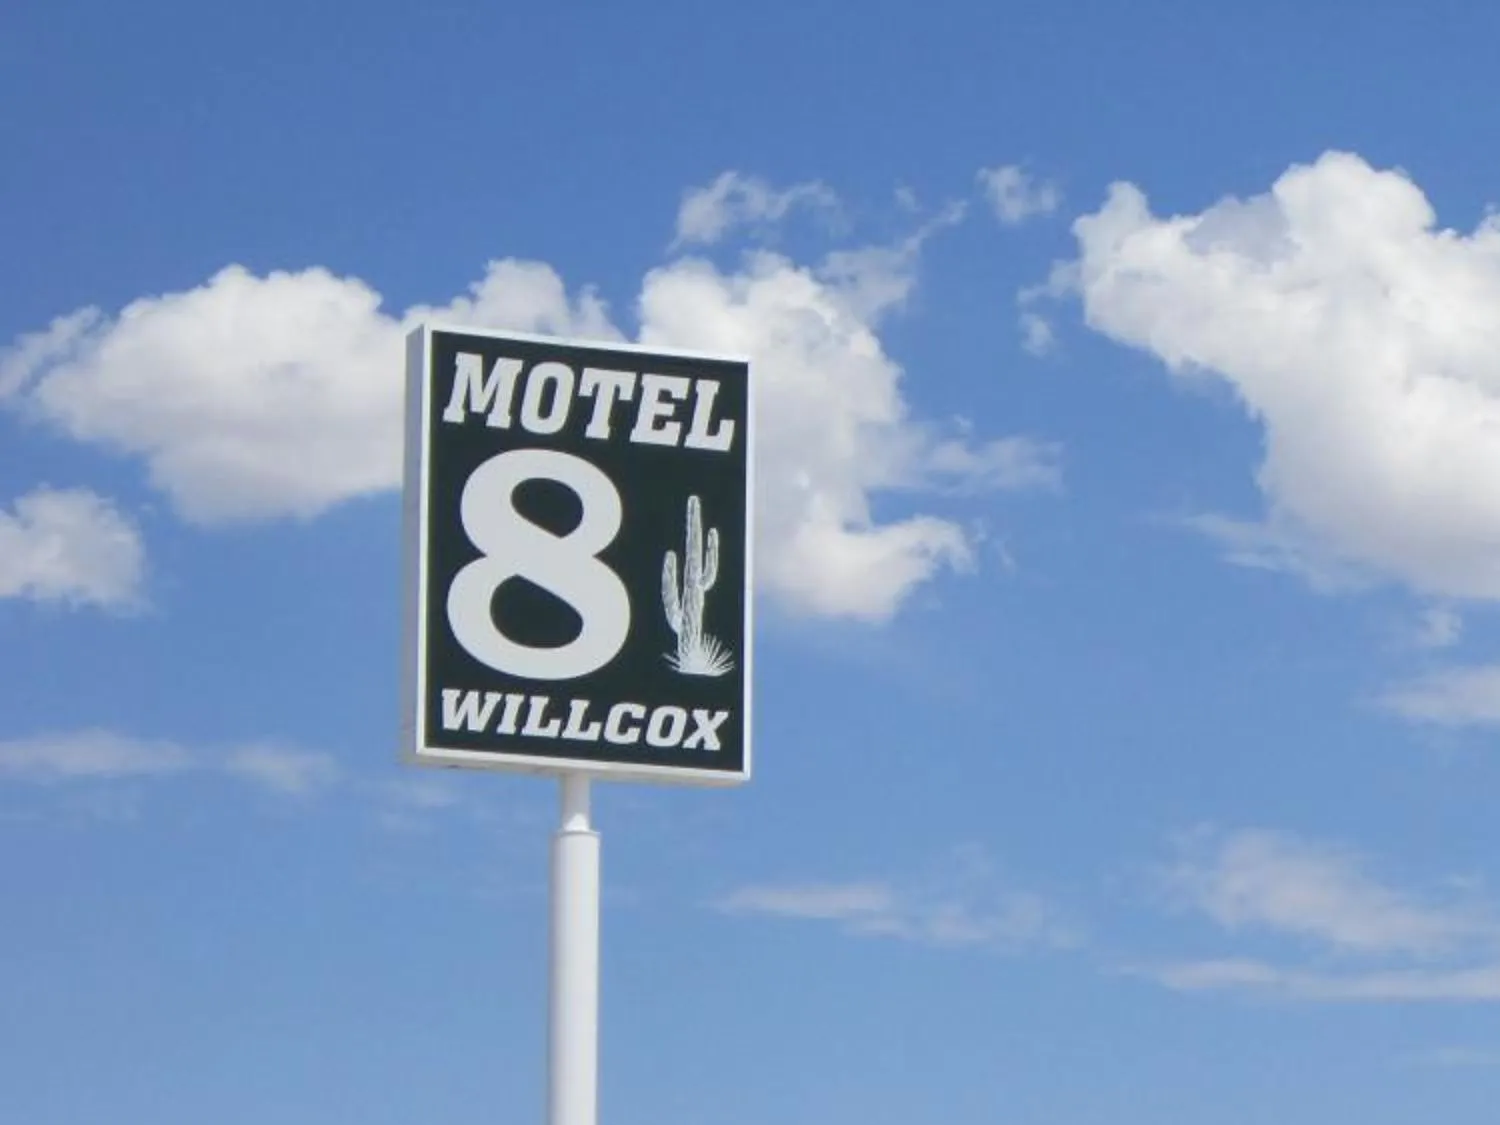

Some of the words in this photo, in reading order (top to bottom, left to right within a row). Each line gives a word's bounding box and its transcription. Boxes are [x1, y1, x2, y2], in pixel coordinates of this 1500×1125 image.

[442, 352, 735, 452] MOTEL
[446, 448, 631, 681] 8
[441, 688, 729, 751] WILLCOX
